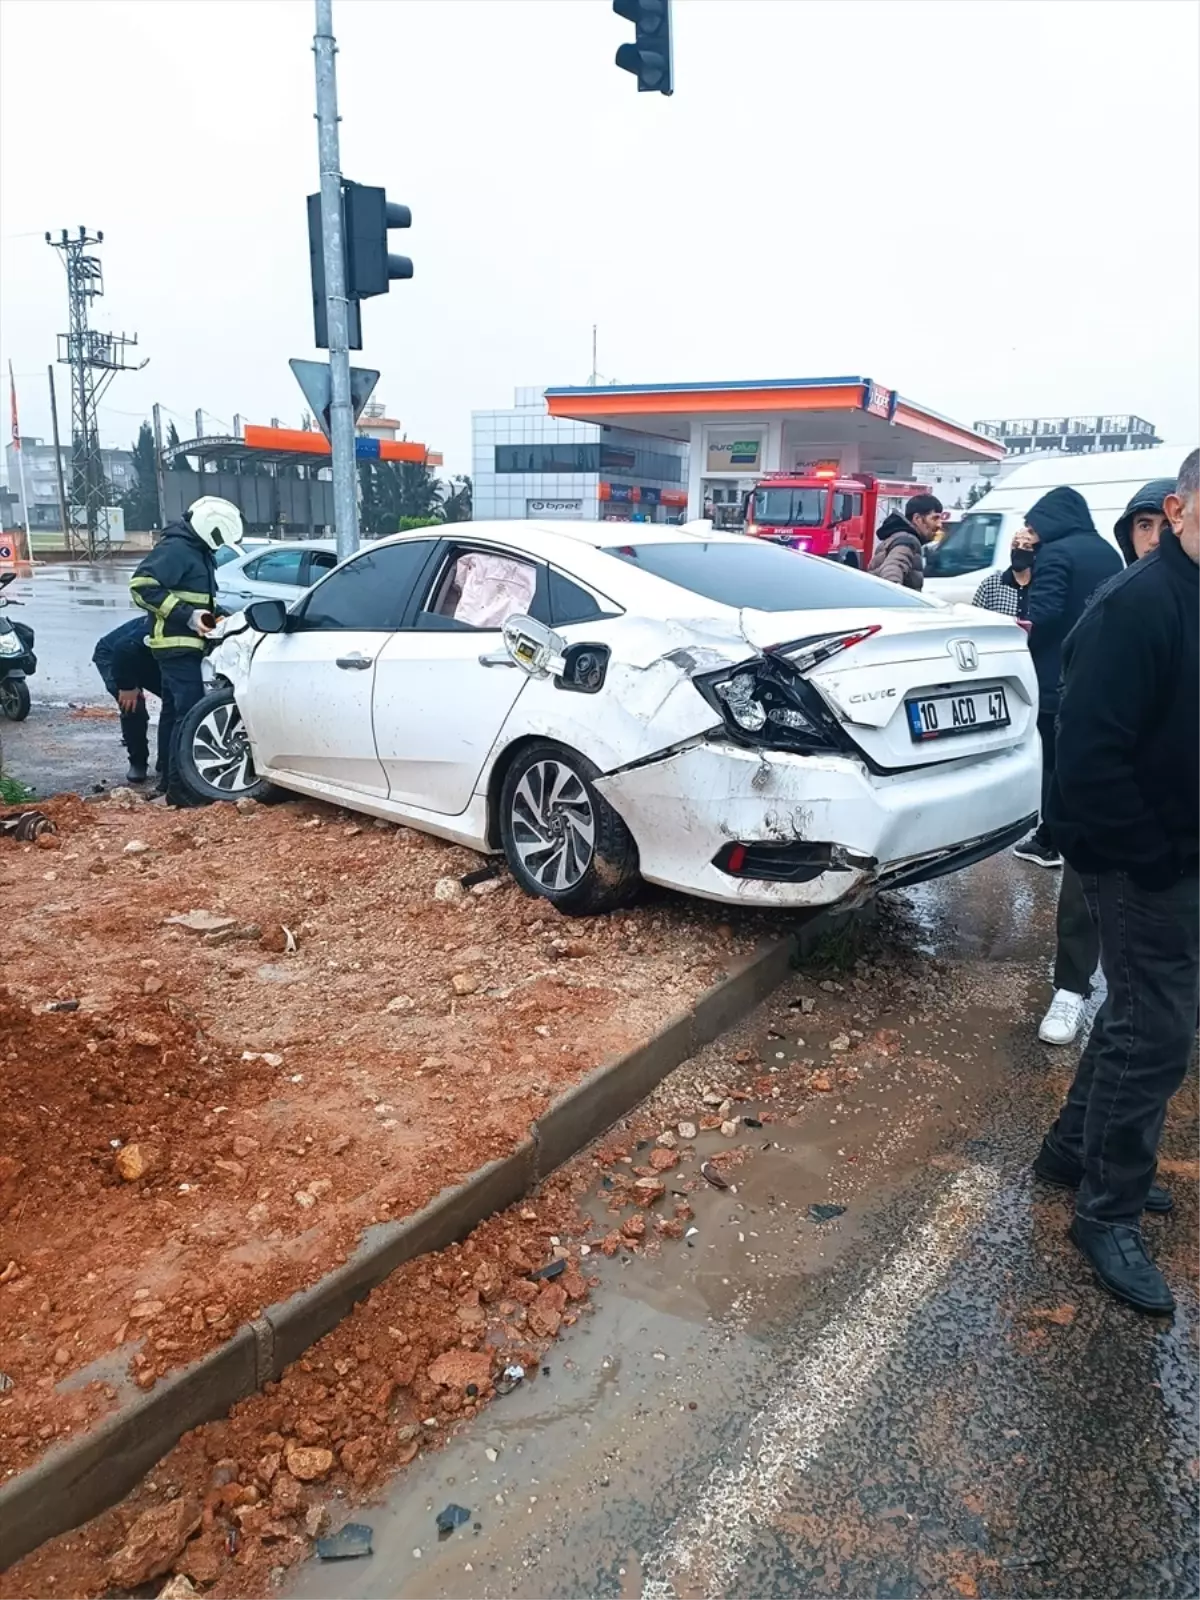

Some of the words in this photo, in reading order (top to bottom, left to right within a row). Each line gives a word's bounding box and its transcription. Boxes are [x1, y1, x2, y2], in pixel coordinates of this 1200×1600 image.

[849, 688, 896, 704] CIVIC
[920, 702, 939, 730] 10
[951, 697, 977, 726] ACD
[988, 693, 1003, 719] 47
